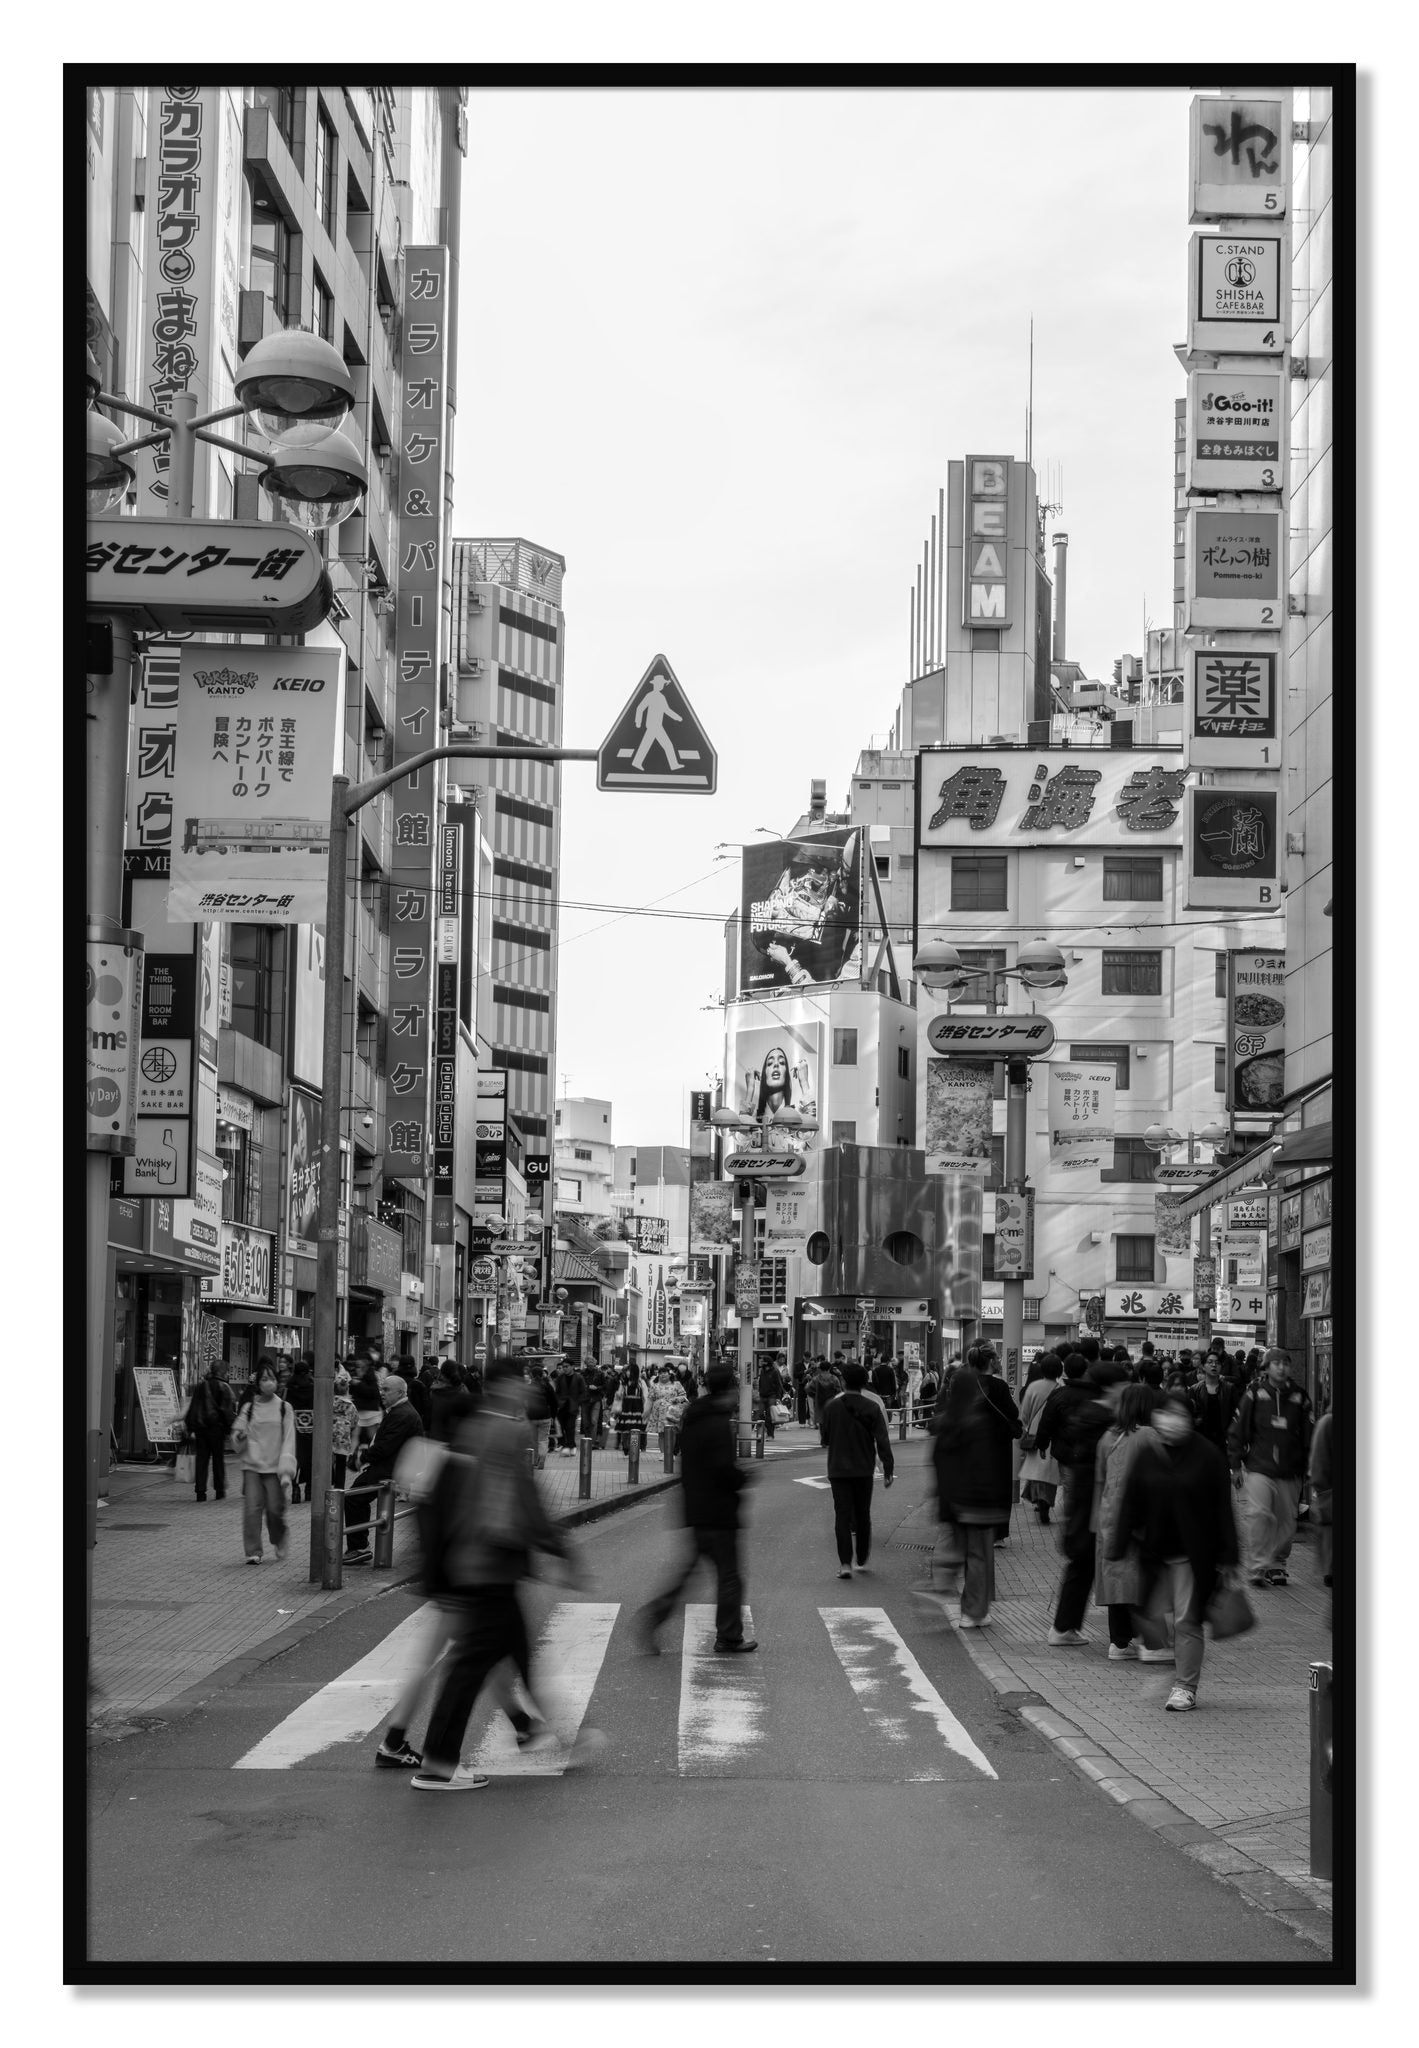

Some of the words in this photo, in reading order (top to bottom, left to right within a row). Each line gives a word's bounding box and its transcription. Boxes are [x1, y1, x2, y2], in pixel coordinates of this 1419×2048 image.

[157, 100, 203, 251] カラオケ
[1264, 193, 1277, 210] 5
[1216, 244, 1265, 255] C.STAND
[1216, 289, 1265, 300] SHISHA
[1216, 301, 1264, 310] CAFE&BAR
[1262, 331, 1276, 348] 4
[1214, 395, 1274, 413] Goo-it!
[1206, 416, 1270, 427] 渋谷宇田川町店
[1201, 444, 1275, 457] 全身もみほぐし
[1261, 468, 1275, 487] 3
[970, 460, 1008, 620] BEAM
[1202, 546, 1272, 567] ポムの樹
[1213, 571, 1263, 580] Pomme-no-ki
[1261, 607, 1274, 624] 2
[207, 687, 245, 695] KANTO
[272, 677, 326, 693] KEIO
[1206, 659, 1261, 715] 薬
[1199, 719, 1267, 734] マツモトキヨシ
[212, 717, 230, 763] 冒険へ
[232, 717, 252, 797] カントーの
[254, 717, 274, 798] ポケパーク
[278, 718, 296, 782] 京王線で
[1260, 746, 1270, 763] 1
[928, 764, 1189, 831] 角海老
[1200, 807, 1266, 859] 一蘭
[445, 830, 455, 868] kimono
[198, 893, 294, 908] 渋谷センター街
[1259, 886, 1272, 903] B
[149, 975, 173, 983] THIRD
[1236, 972, 1285, 986] 四川料理
[149, 1006, 172, 1014] ROOM
[152, 1018, 168, 1026] BAR
[935, 1024, 1047, 1040] 渋谷センター街
[1235, 1035, 1266, 1056] 6F
[1088, 1074, 1112, 1082] KEIO
[96, 1088, 120, 1101] Day!
[141, 1101, 163, 1109] SAKE
[167, 1101, 185, 1109] BAR
[135, 1157, 172, 1170] Whisky
[526, 1161, 549, 1173] GU
[727, 1158, 795, 1169] 渋谷センター街
[135, 1168, 157, 1178] Bank
[1157, 1169, 1219, 1179] 渋谷センター街
[110, 1180, 121, 1191] 1F
[230, 1242, 245, 1293] 50
[1120, 1291, 1185, 1315] 兆楽
[655, 1289, 665, 1336] BEER
